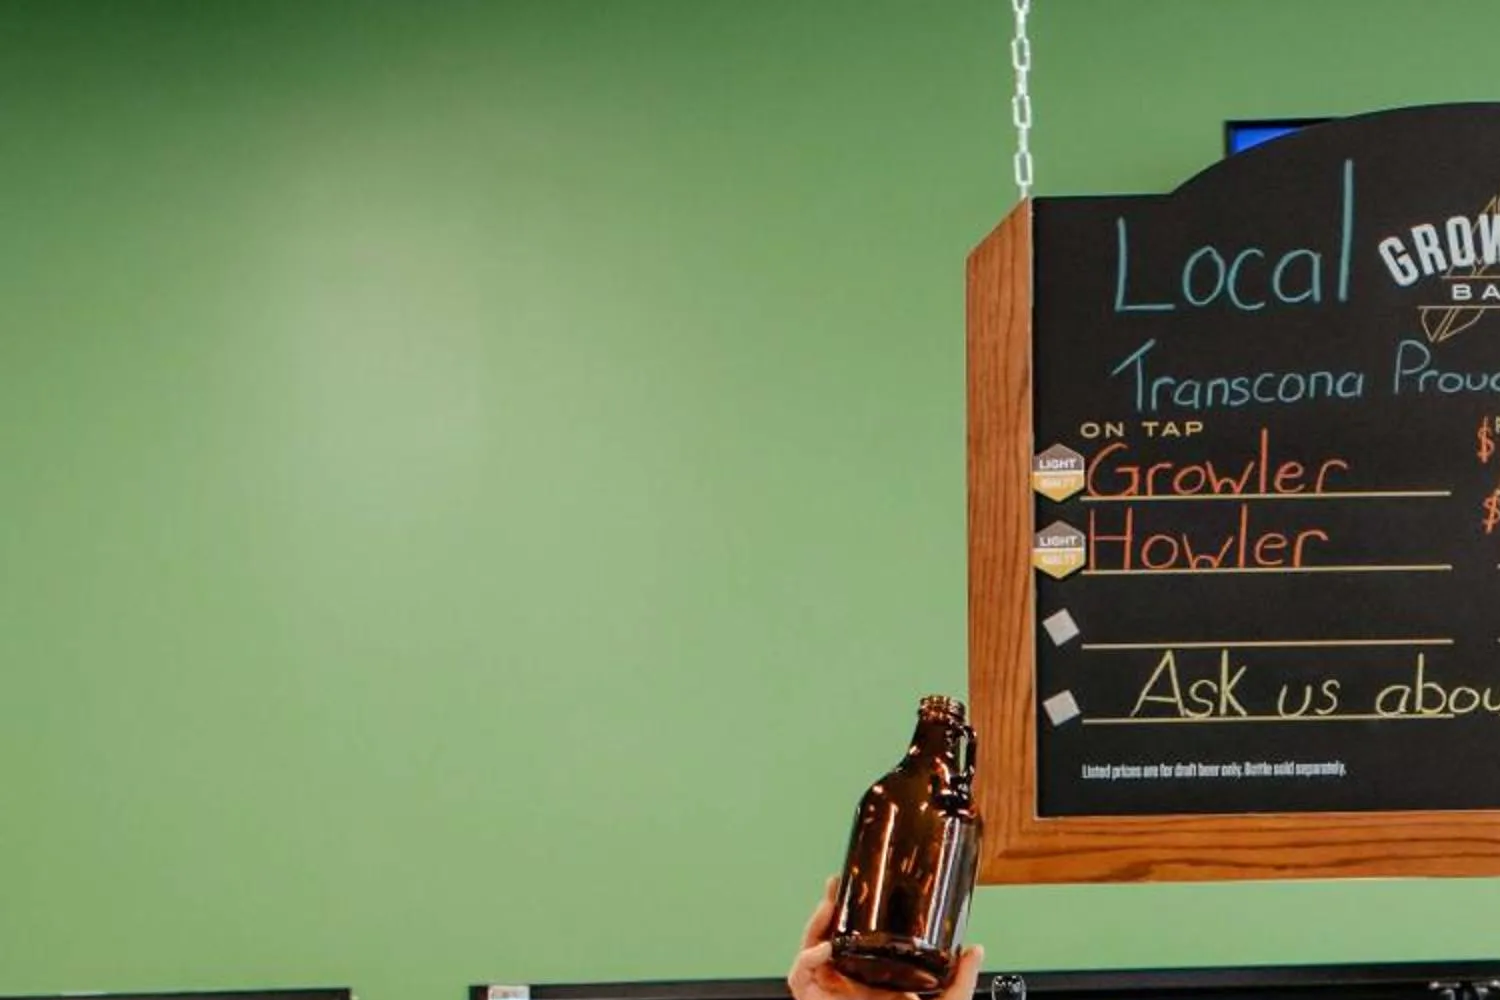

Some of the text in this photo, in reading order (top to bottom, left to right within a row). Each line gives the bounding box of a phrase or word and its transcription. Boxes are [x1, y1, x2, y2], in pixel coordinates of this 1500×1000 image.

[1115, 158, 1353, 312] Local
[1111, 339, 1363, 411] Transcona
[1080, 420, 1204, 438] ON TAP
[1086, 427, 1349, 498] Growler
[1039, 459, 1077, 469] LIGHT
[1039, 535, 1078, 547] LIGHT
[1088, 503, 1329, 571] Howler
[1130, 648, 1247, 719] Ask
[1277, 678, 1340, 718] us
[1081, 763, 1111, 779] Listed
